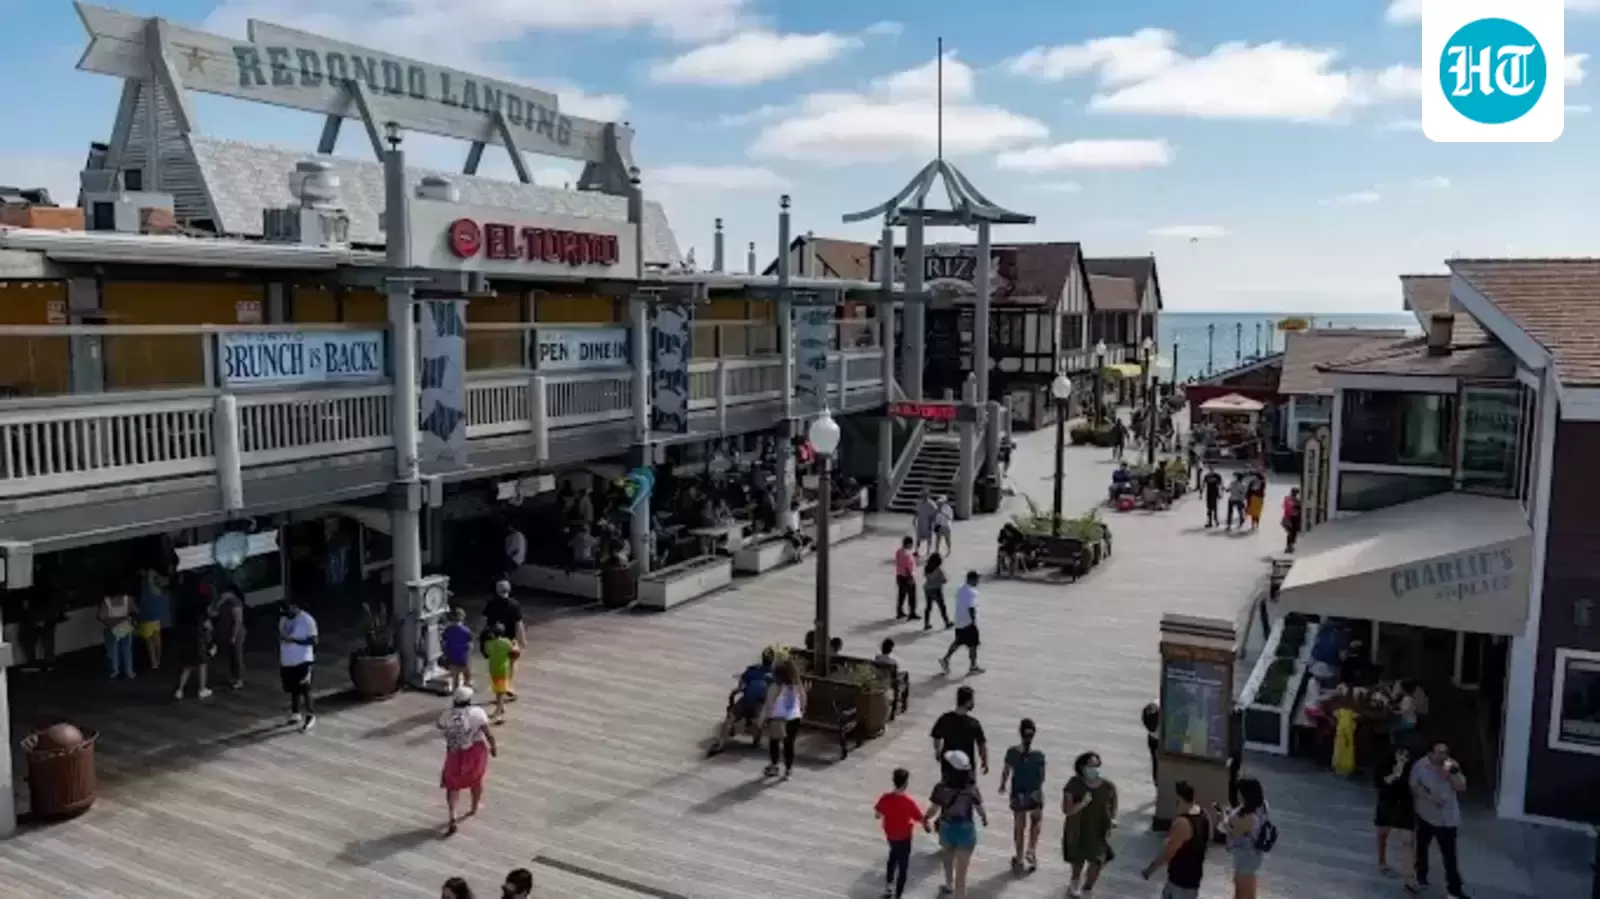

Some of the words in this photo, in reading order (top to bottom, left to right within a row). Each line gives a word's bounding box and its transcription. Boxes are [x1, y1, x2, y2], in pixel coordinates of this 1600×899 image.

[232, 45, 427, 100] REDONDO
[440, 72, 573, 146] LANDING
[484, 223, 520, 260] EL
[225, 343, 305, 378] BRUNCH
[324, 340, 380, 374] BACK!
[539, 342, 569, 361] PEN
